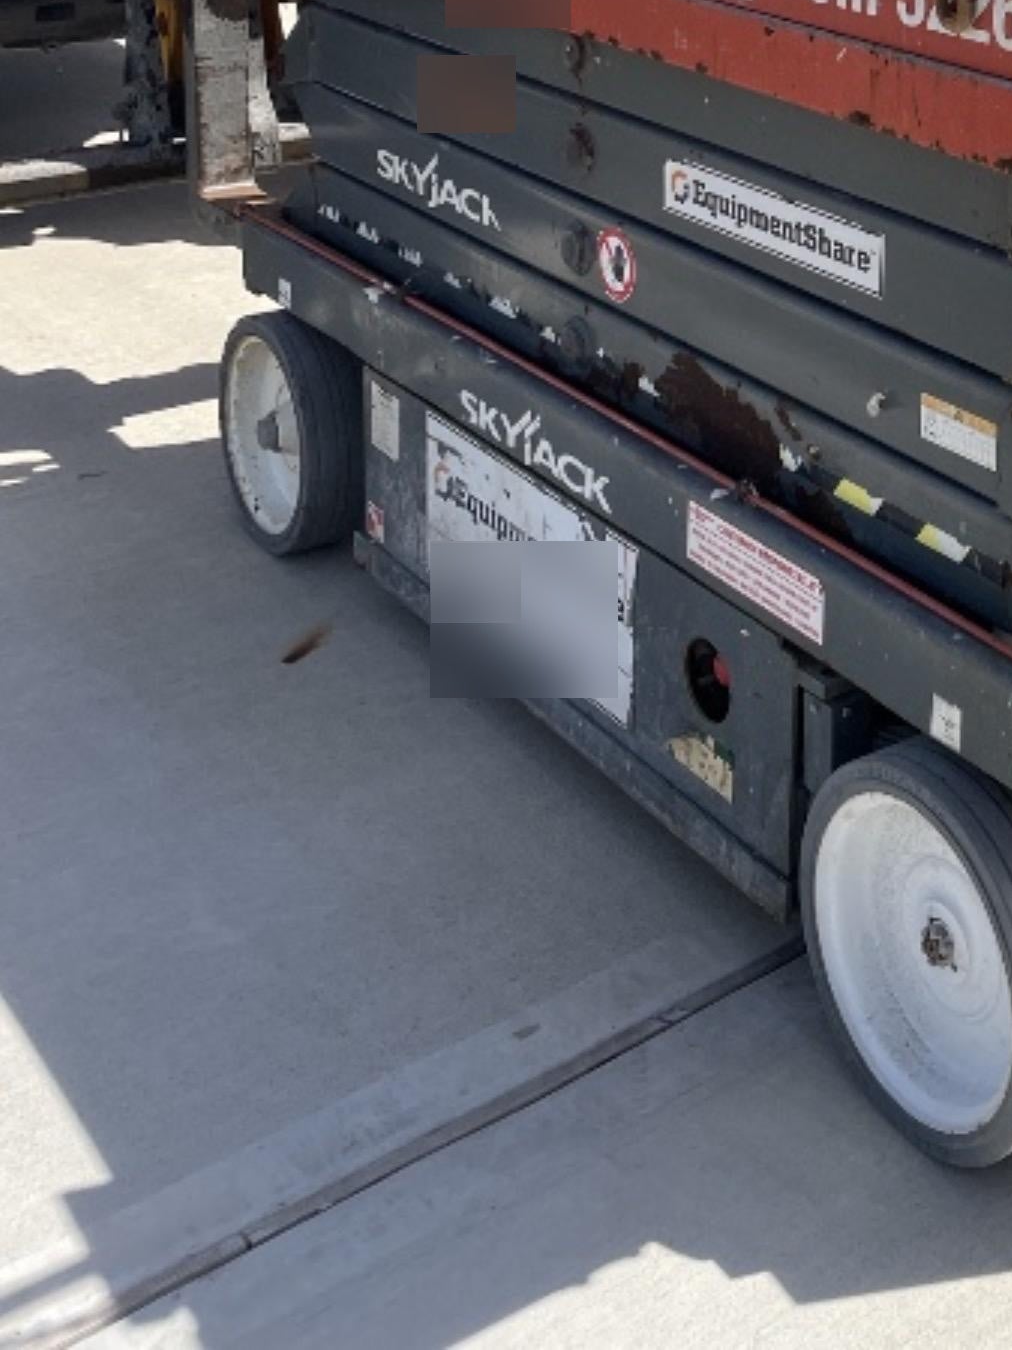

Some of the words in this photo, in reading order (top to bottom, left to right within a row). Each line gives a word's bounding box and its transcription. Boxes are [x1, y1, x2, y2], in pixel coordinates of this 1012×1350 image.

[376, 149, 502, 231] SKYJACK
[692, 179, 871, 274] EquipmentShare
[460, 389, 612, 514] SKYJACK
